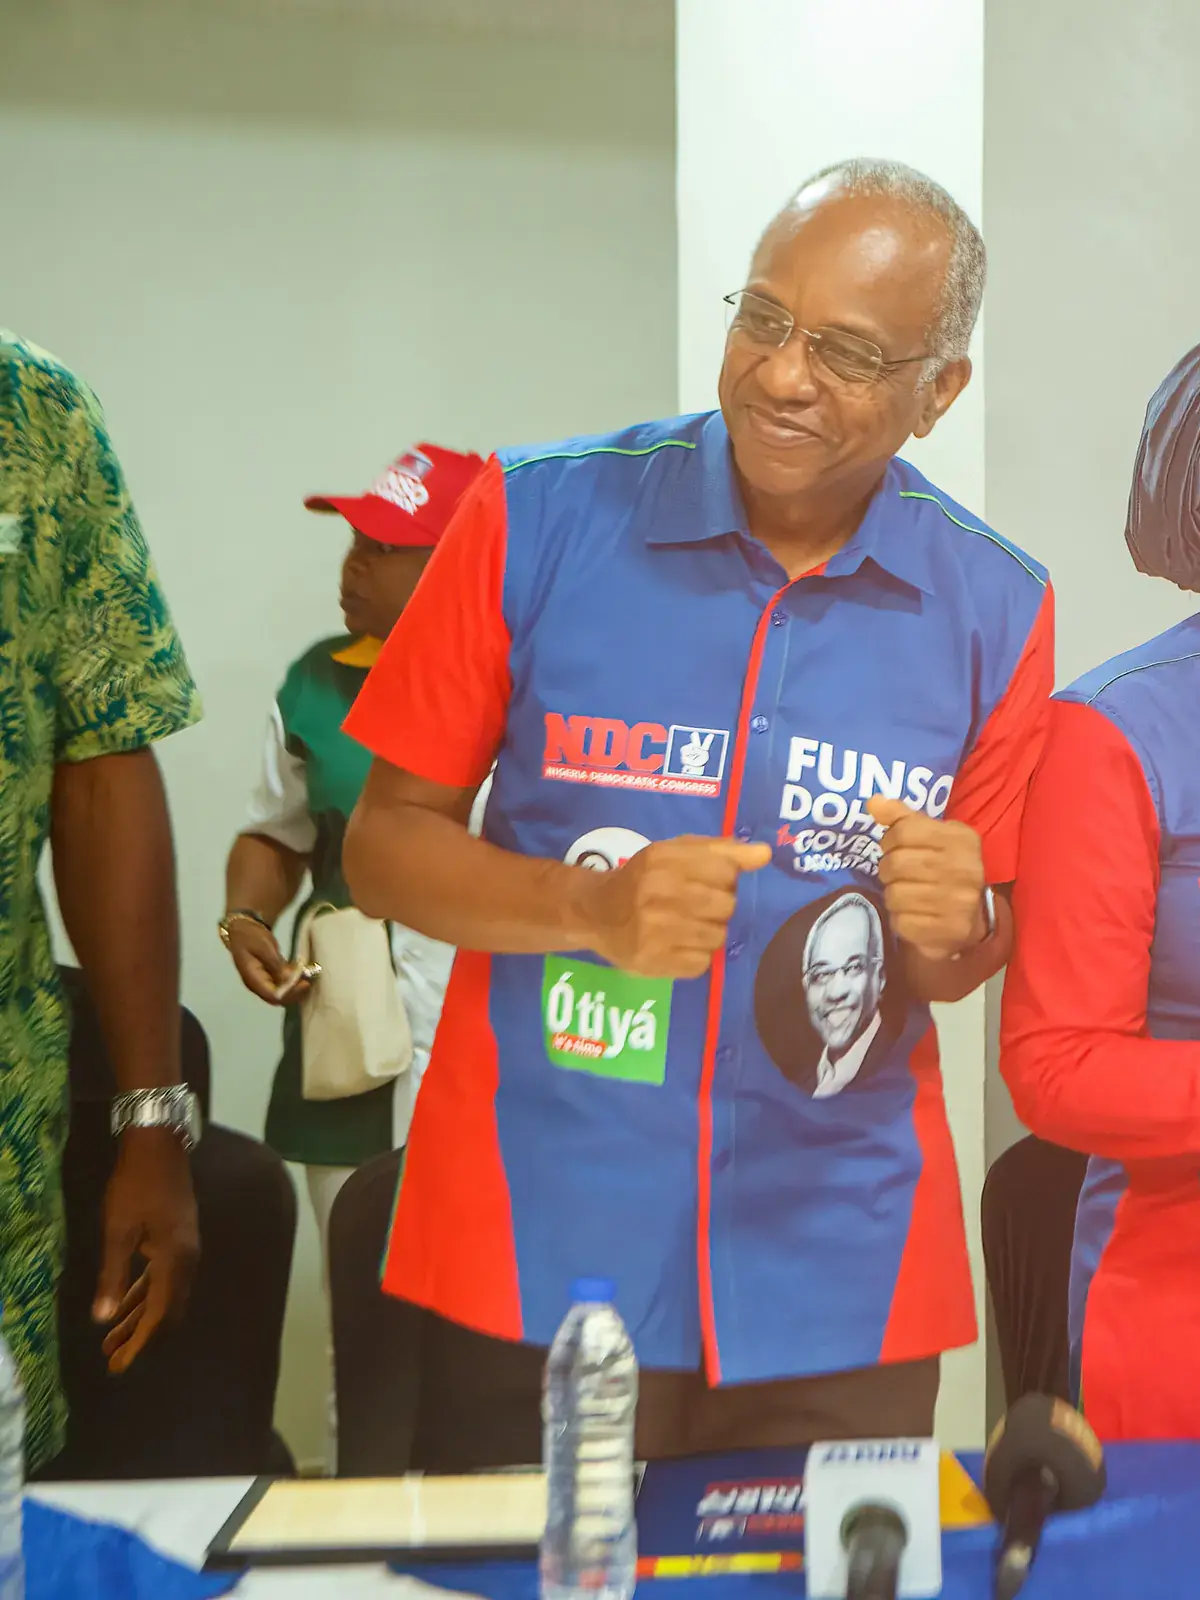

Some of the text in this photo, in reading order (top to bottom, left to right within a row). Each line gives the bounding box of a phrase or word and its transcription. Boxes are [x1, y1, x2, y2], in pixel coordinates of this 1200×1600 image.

[543, 711, 668, 773] NDC
[546, 765, 718, 795] NIGERIA DEMOCRATIC CONGRESS
[786, 736, 954, 818] FUNSO
